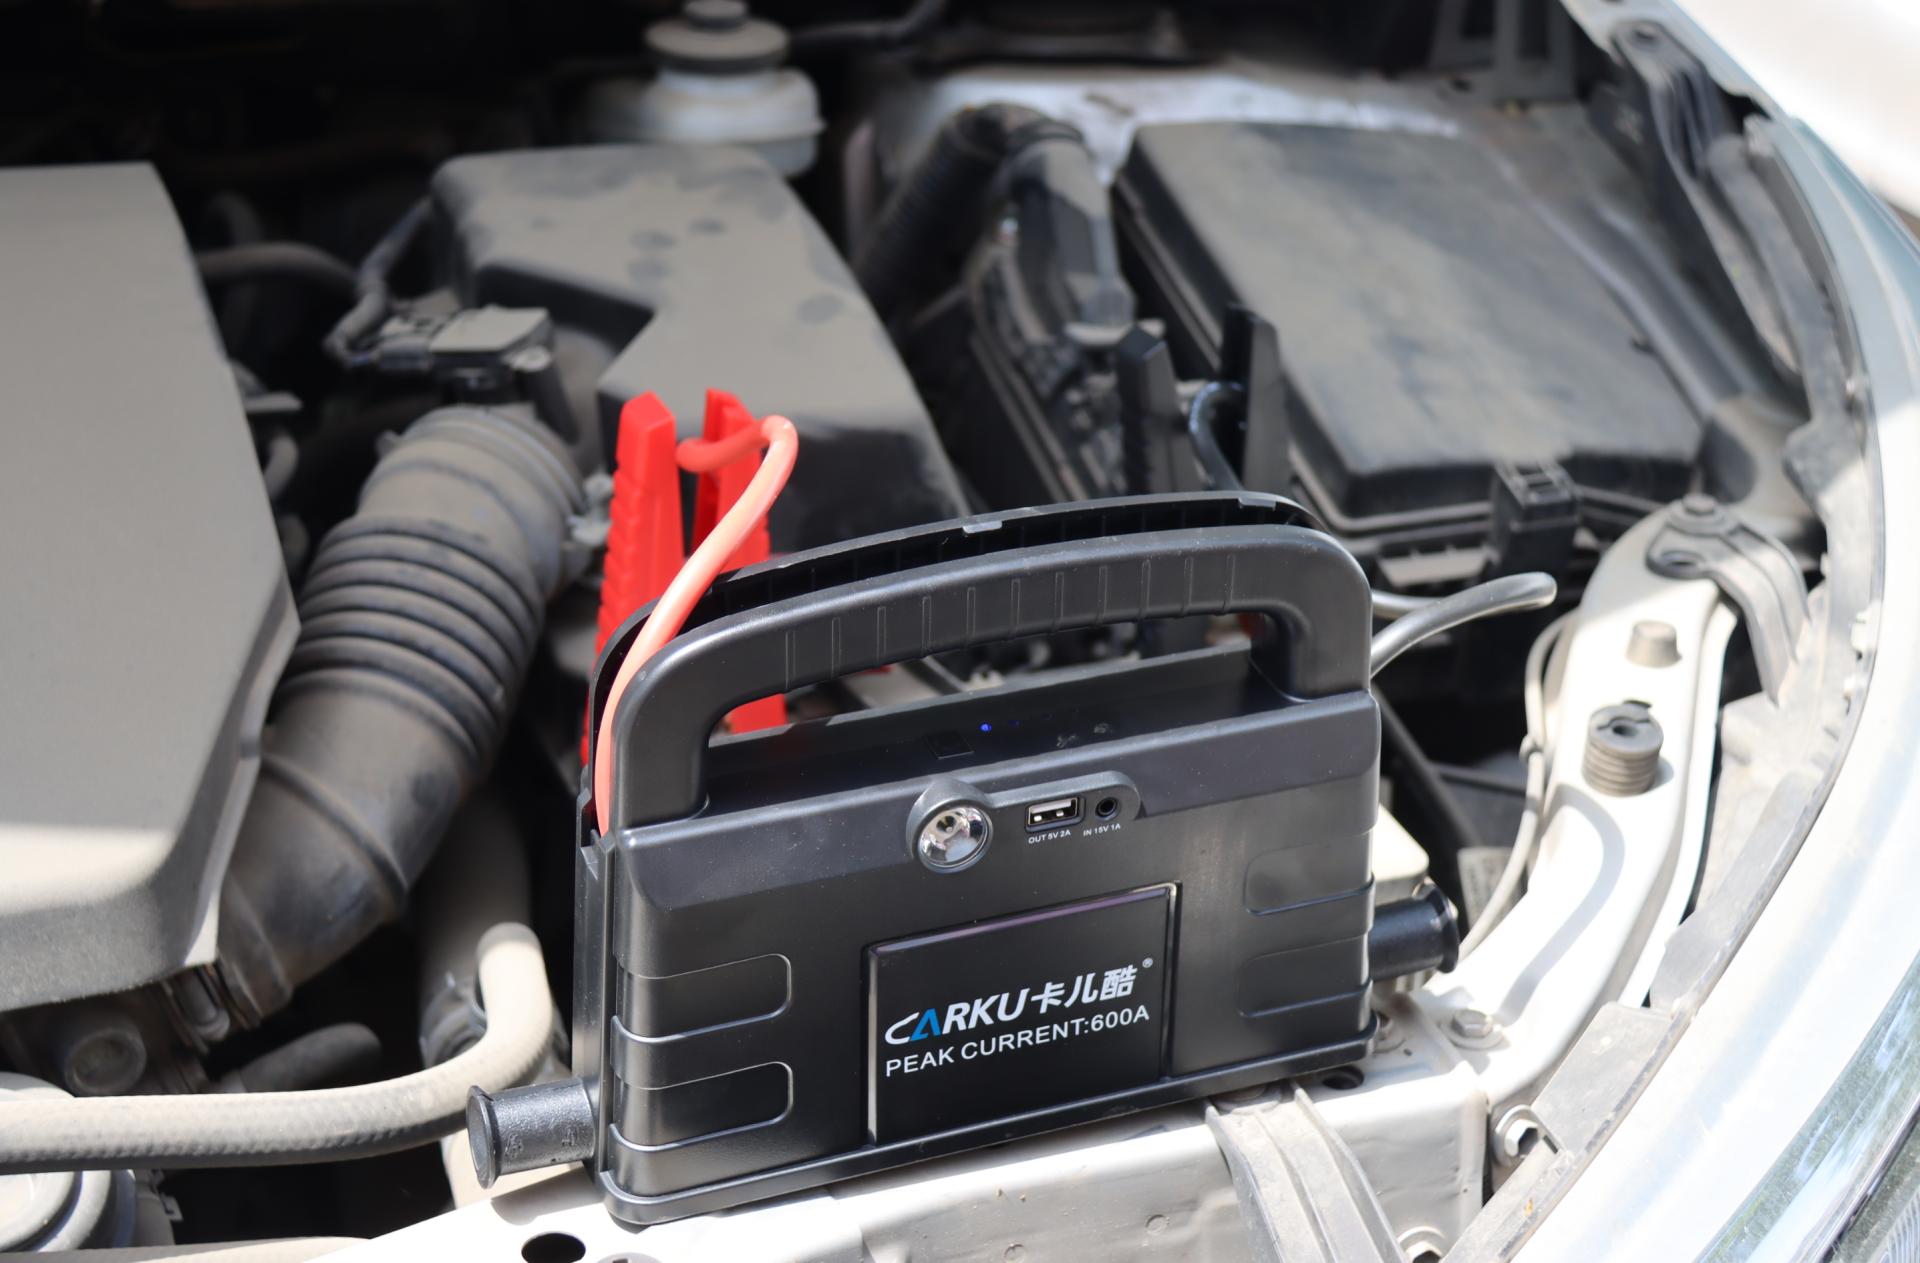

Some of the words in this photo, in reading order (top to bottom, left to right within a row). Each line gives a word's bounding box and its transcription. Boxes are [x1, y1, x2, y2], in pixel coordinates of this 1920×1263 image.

[1028, 834, 1047, 845] OUT
[1048, 831, 1059, 840] 5V
[1059, 829, 1071, 838] 2A
[1083, 829, 1091, 837] IN
[1094, 825, 1108, 834] 15V
[1110, 823, 1121, 831] 1A
[885, 988, 1030, 1045] CARKU
[886, 1046, 954, 1077] PEAK
[961, 1005, 1150, 1060] CURRENT:600A
